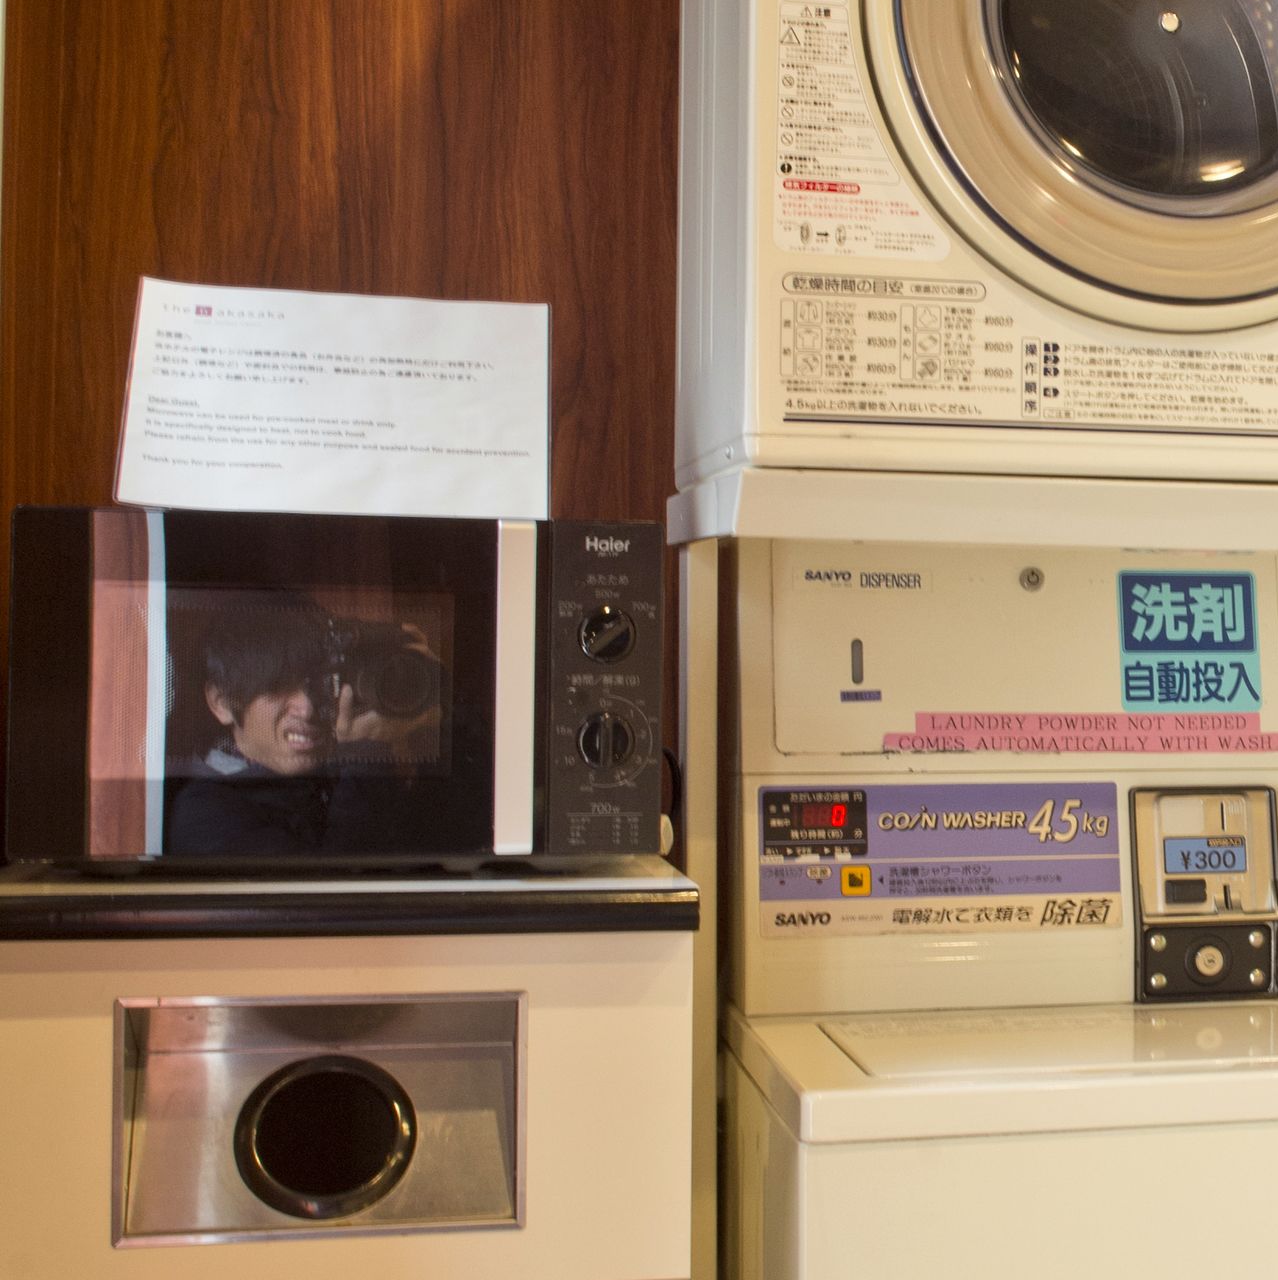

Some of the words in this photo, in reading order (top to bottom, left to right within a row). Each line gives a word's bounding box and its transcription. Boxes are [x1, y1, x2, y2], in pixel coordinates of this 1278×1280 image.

[792, 276, 904, 296] 乾燥時間の目安
[585, 536, 631, 552] Haier
[804, 570, 852, 582] SANYO
[860, 572, 922, 589] DISPENSER
[1131, 582, 1246, 643] 洗剤
[1124, 660, 1261, 704] 自動投入
[930, 715, 1026, 732] LAUNDRY
[1038, 716, 1118, 731] POWDER
[1127, 716, 1166, 731] NOT
[1174, 716, 1247, 730] NEEDED
[898, 735, 966, 752] COMES
[975, 734, 1149, 752] AUTOMATICALLY
[1159, 734, 1209, 750] WITH
[1218, 734, 1273, 750] WASH
[831, 803, 847, 827] 0
[943, 811, 1027, 830] WASHER
[1181, 849, 1237, 870] ¥300
[774, 911, 832, 927] SANYO
[1041, 898, 1113, 927] 除菌
